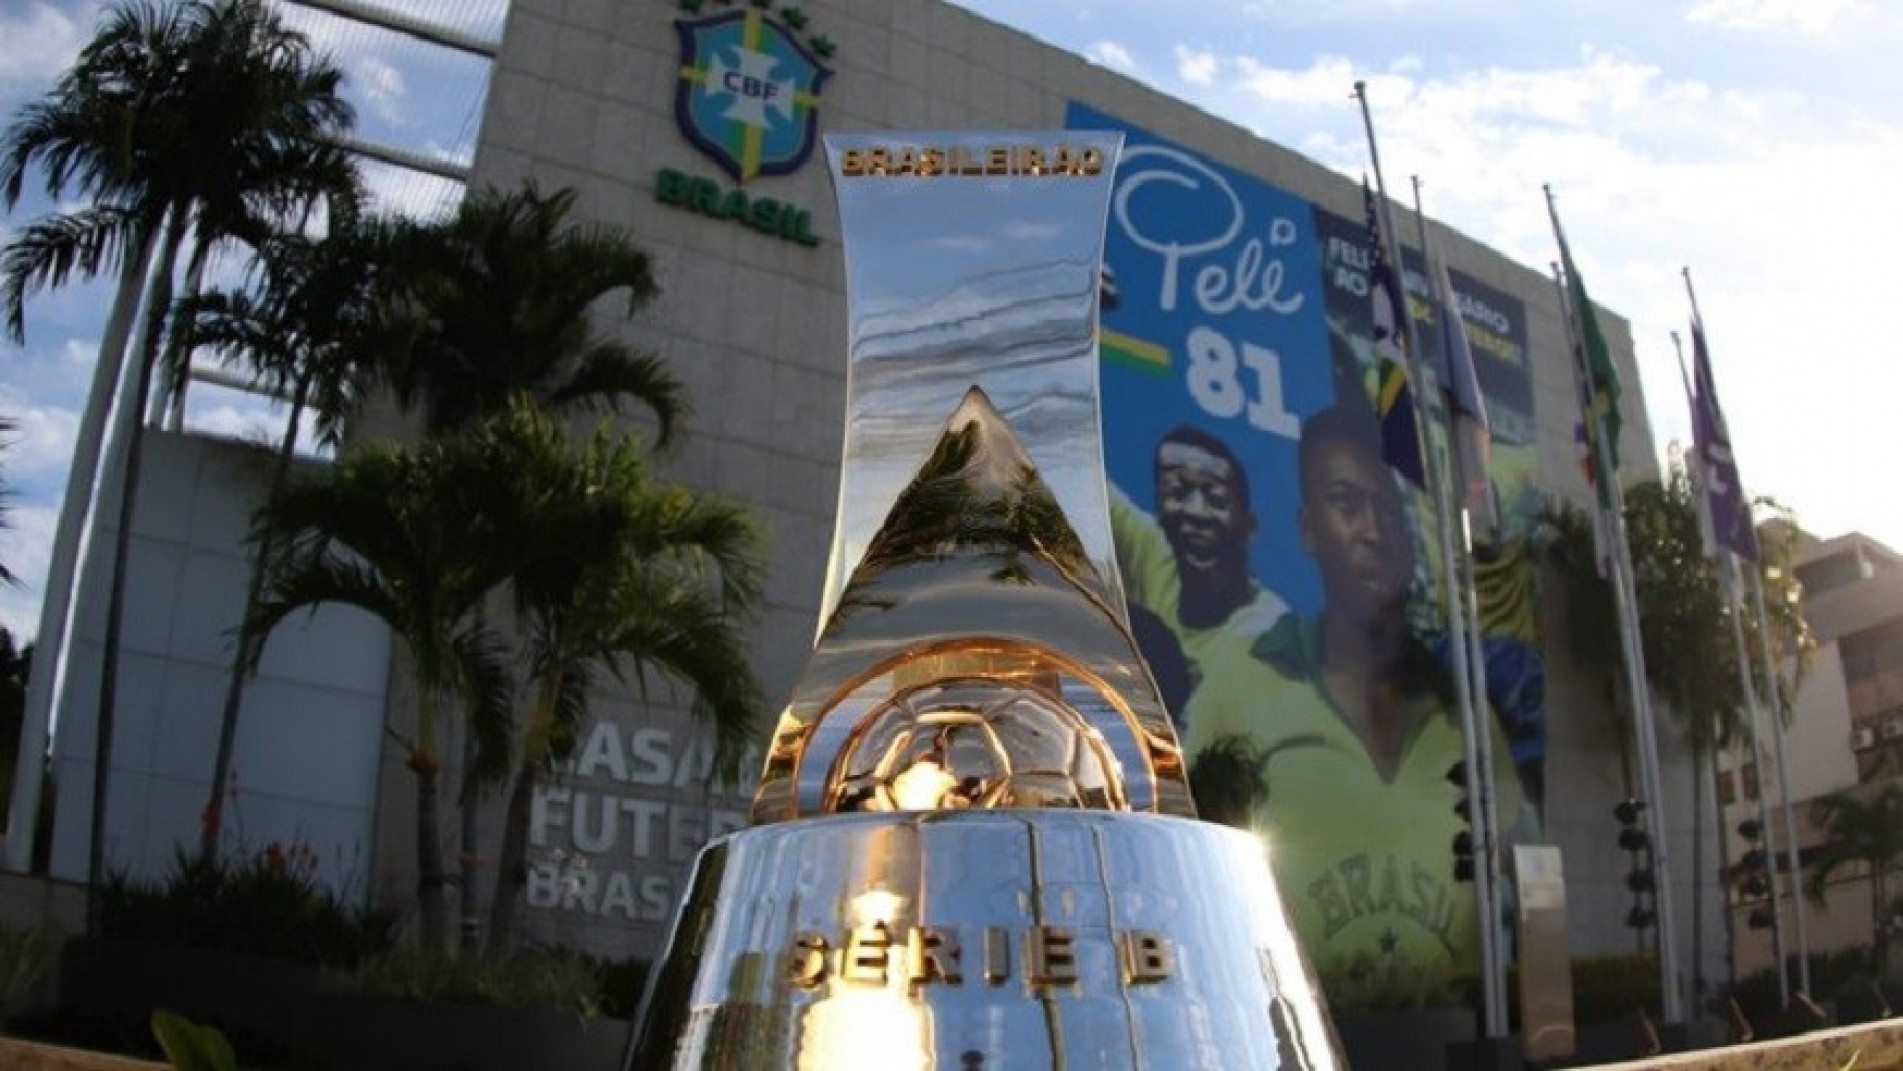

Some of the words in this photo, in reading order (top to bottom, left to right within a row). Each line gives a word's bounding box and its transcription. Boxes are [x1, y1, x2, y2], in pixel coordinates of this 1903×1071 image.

[723, 71, 779, 101] CBF
[655, 167, 819, 247] BRASIL
[1186, 326, 1300, 440] 81
[550, 721, 724, 787] ASA
[1119, 930, 1176, 986] B
